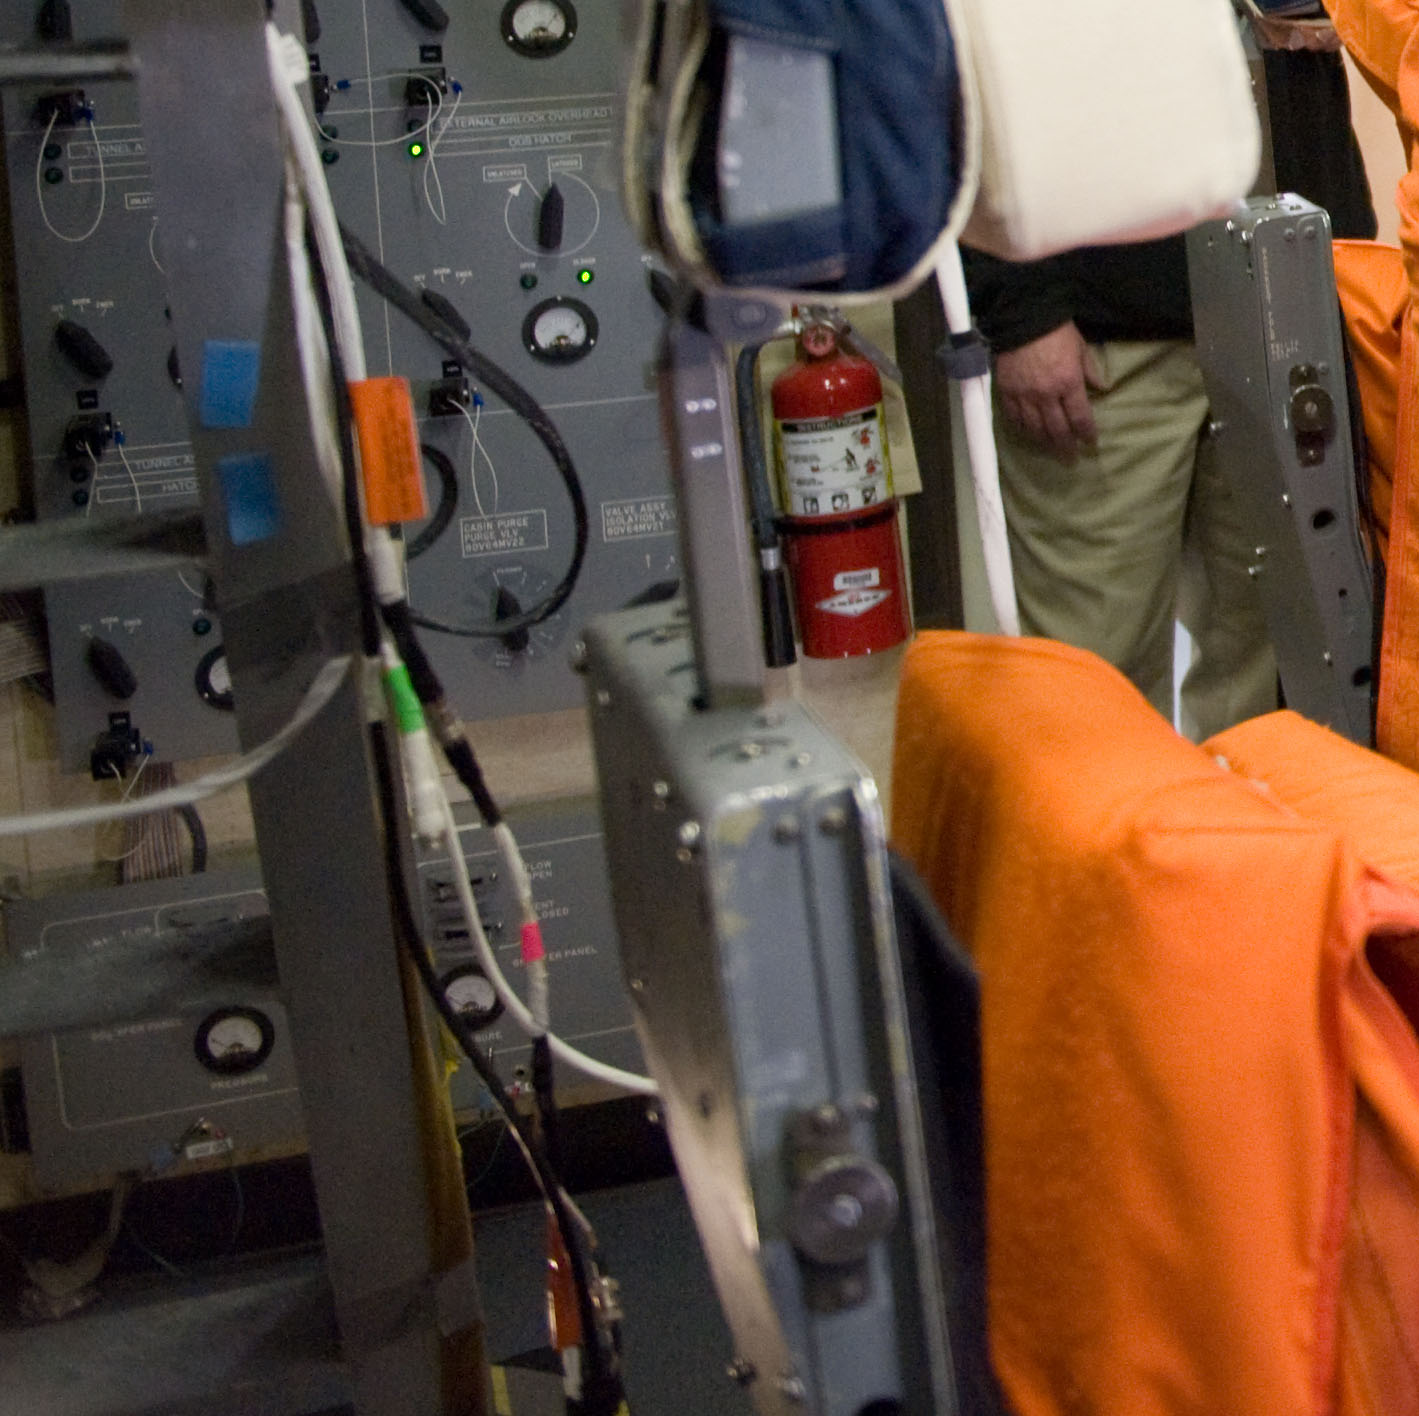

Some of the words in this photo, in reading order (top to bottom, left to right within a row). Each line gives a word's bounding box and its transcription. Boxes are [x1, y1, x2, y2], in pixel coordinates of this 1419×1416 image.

[499, 113, 545, 126] AIRLOCK
[532, 134, 572, 145] HATCH
[605, 505, 636, 517] VALVE
[463, 520, 493, 533] CABIN
[497, 517, 529, 529] PURGE
[605, 512, 656, 527] ISOLATION
[464, 531, 496, 542] PURGE
[564, 946, 599, 958] PANEL
